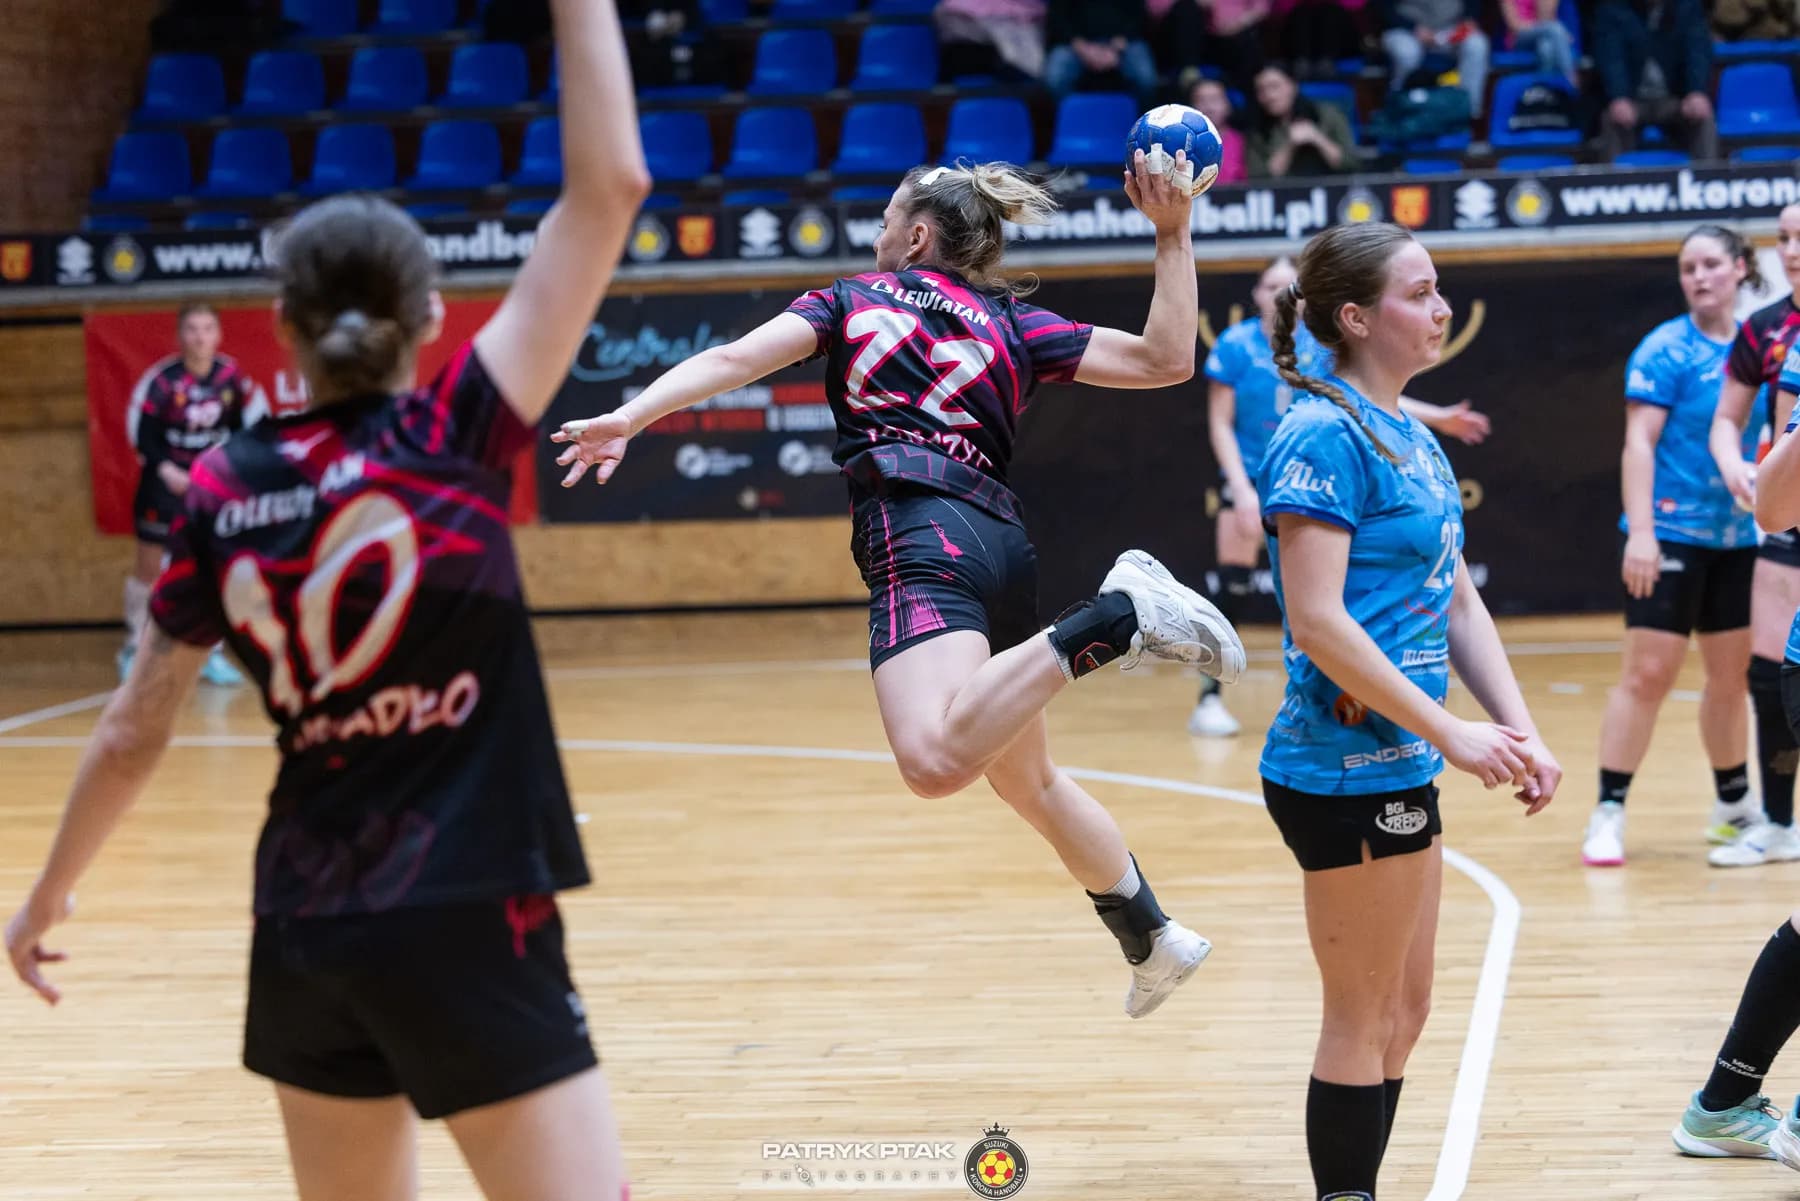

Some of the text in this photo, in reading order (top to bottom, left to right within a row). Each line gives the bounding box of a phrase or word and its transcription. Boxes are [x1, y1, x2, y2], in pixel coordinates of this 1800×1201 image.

[1560, 168, 1800, 217] www.koron
[894, 288, 990, 326] LEWIATAN
[845, 307, 996, 428] 22
[1423, 520, 1461, 589] 25
[221, 489, 421, 716] 10
[1385, 801, 1405, 816] BGI
